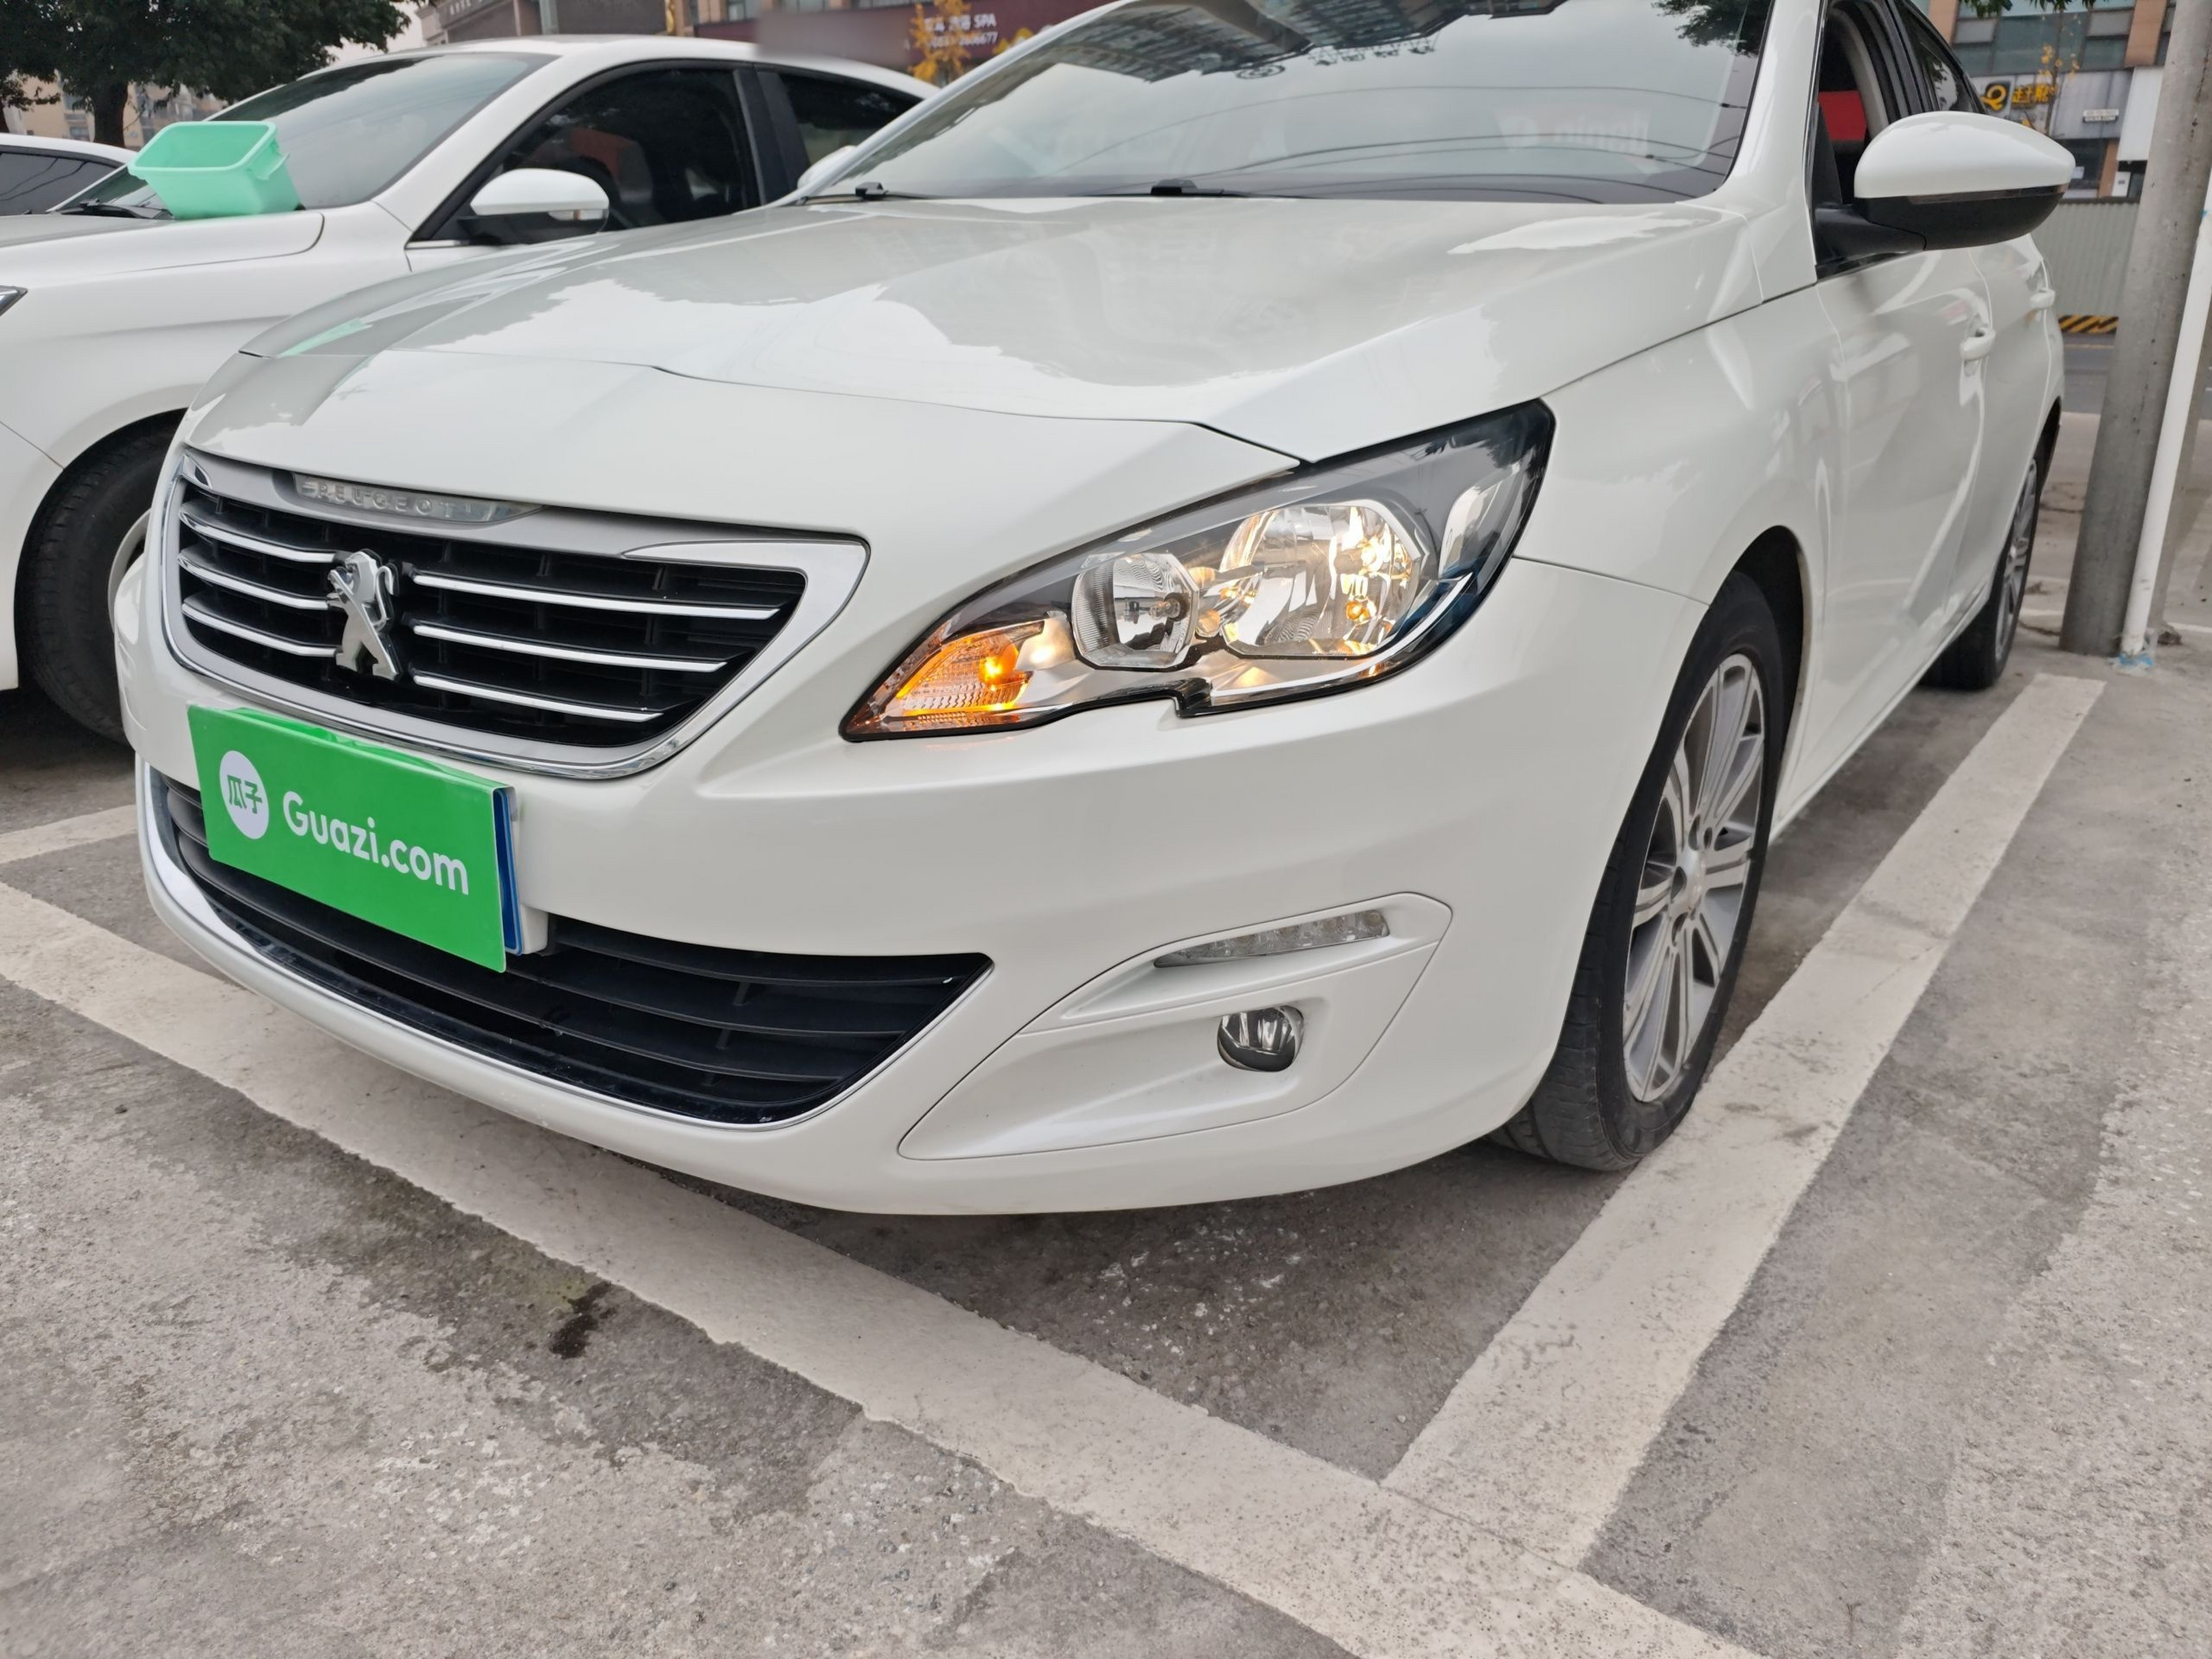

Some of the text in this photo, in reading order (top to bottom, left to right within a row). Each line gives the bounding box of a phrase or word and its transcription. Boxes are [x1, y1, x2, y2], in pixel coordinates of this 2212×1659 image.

[317, 482, 454, 518] PEUGEOT
[227, 774, 263, 814] 瓜子
[283, 791, 469, 895] Guazi.com
